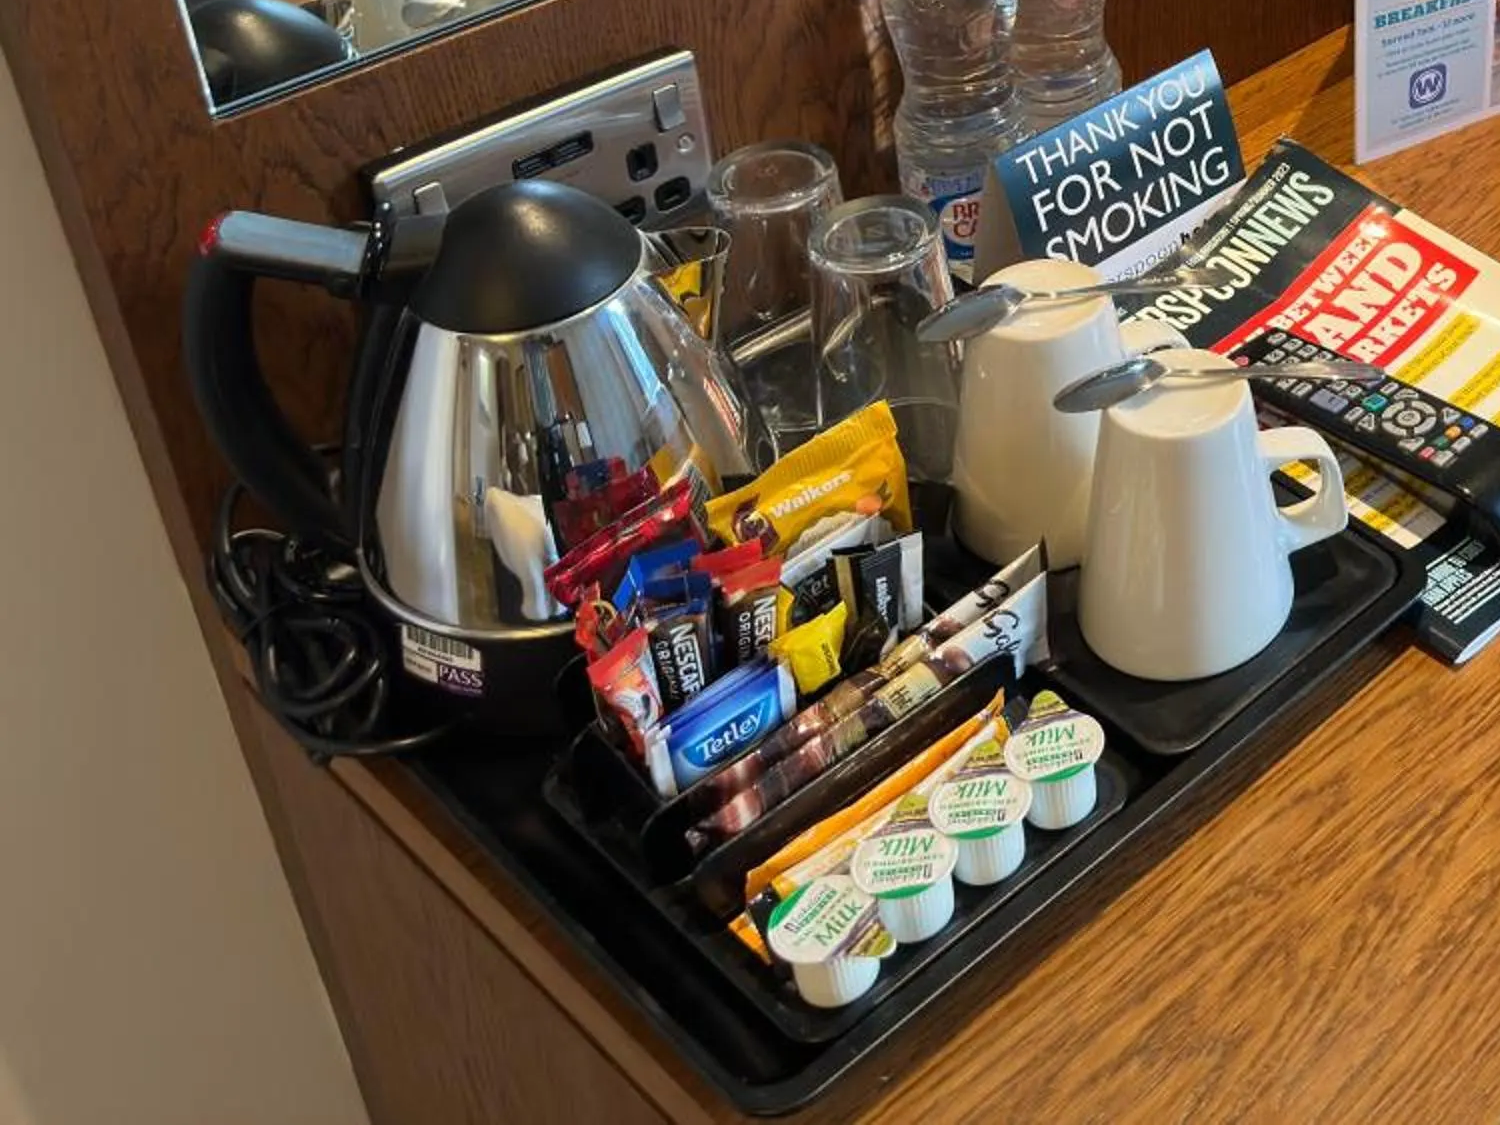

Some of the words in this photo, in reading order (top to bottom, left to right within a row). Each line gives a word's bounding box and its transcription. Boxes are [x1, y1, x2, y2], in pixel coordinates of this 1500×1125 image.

[1015, 103, 1139, 184] THANK
[1140, 65, 1208, 121] YOU
[1031, 158, 1123, 232] FOR
[1129, 101, 1215, 179] NOT
[1045, 146, 1231, 263] SMOKING
[1305, 243, 1422, 350] AND
[1354, 262, 1458, 363] RKETS
[768, 473, 854, 520] Walkers
[749, 592, 777, 658] NESC
[438, 665, 484, 688] PASS
[669, 622, 703, 704] NESCAF
[695, 704, 763, 765] Tetley
[1025, 722, 1077, 743] Milk
[955, 780, 1011, 799] Milk
[878, 834, 936, 855] Milk
[814, 897, 864, 947] Milk
